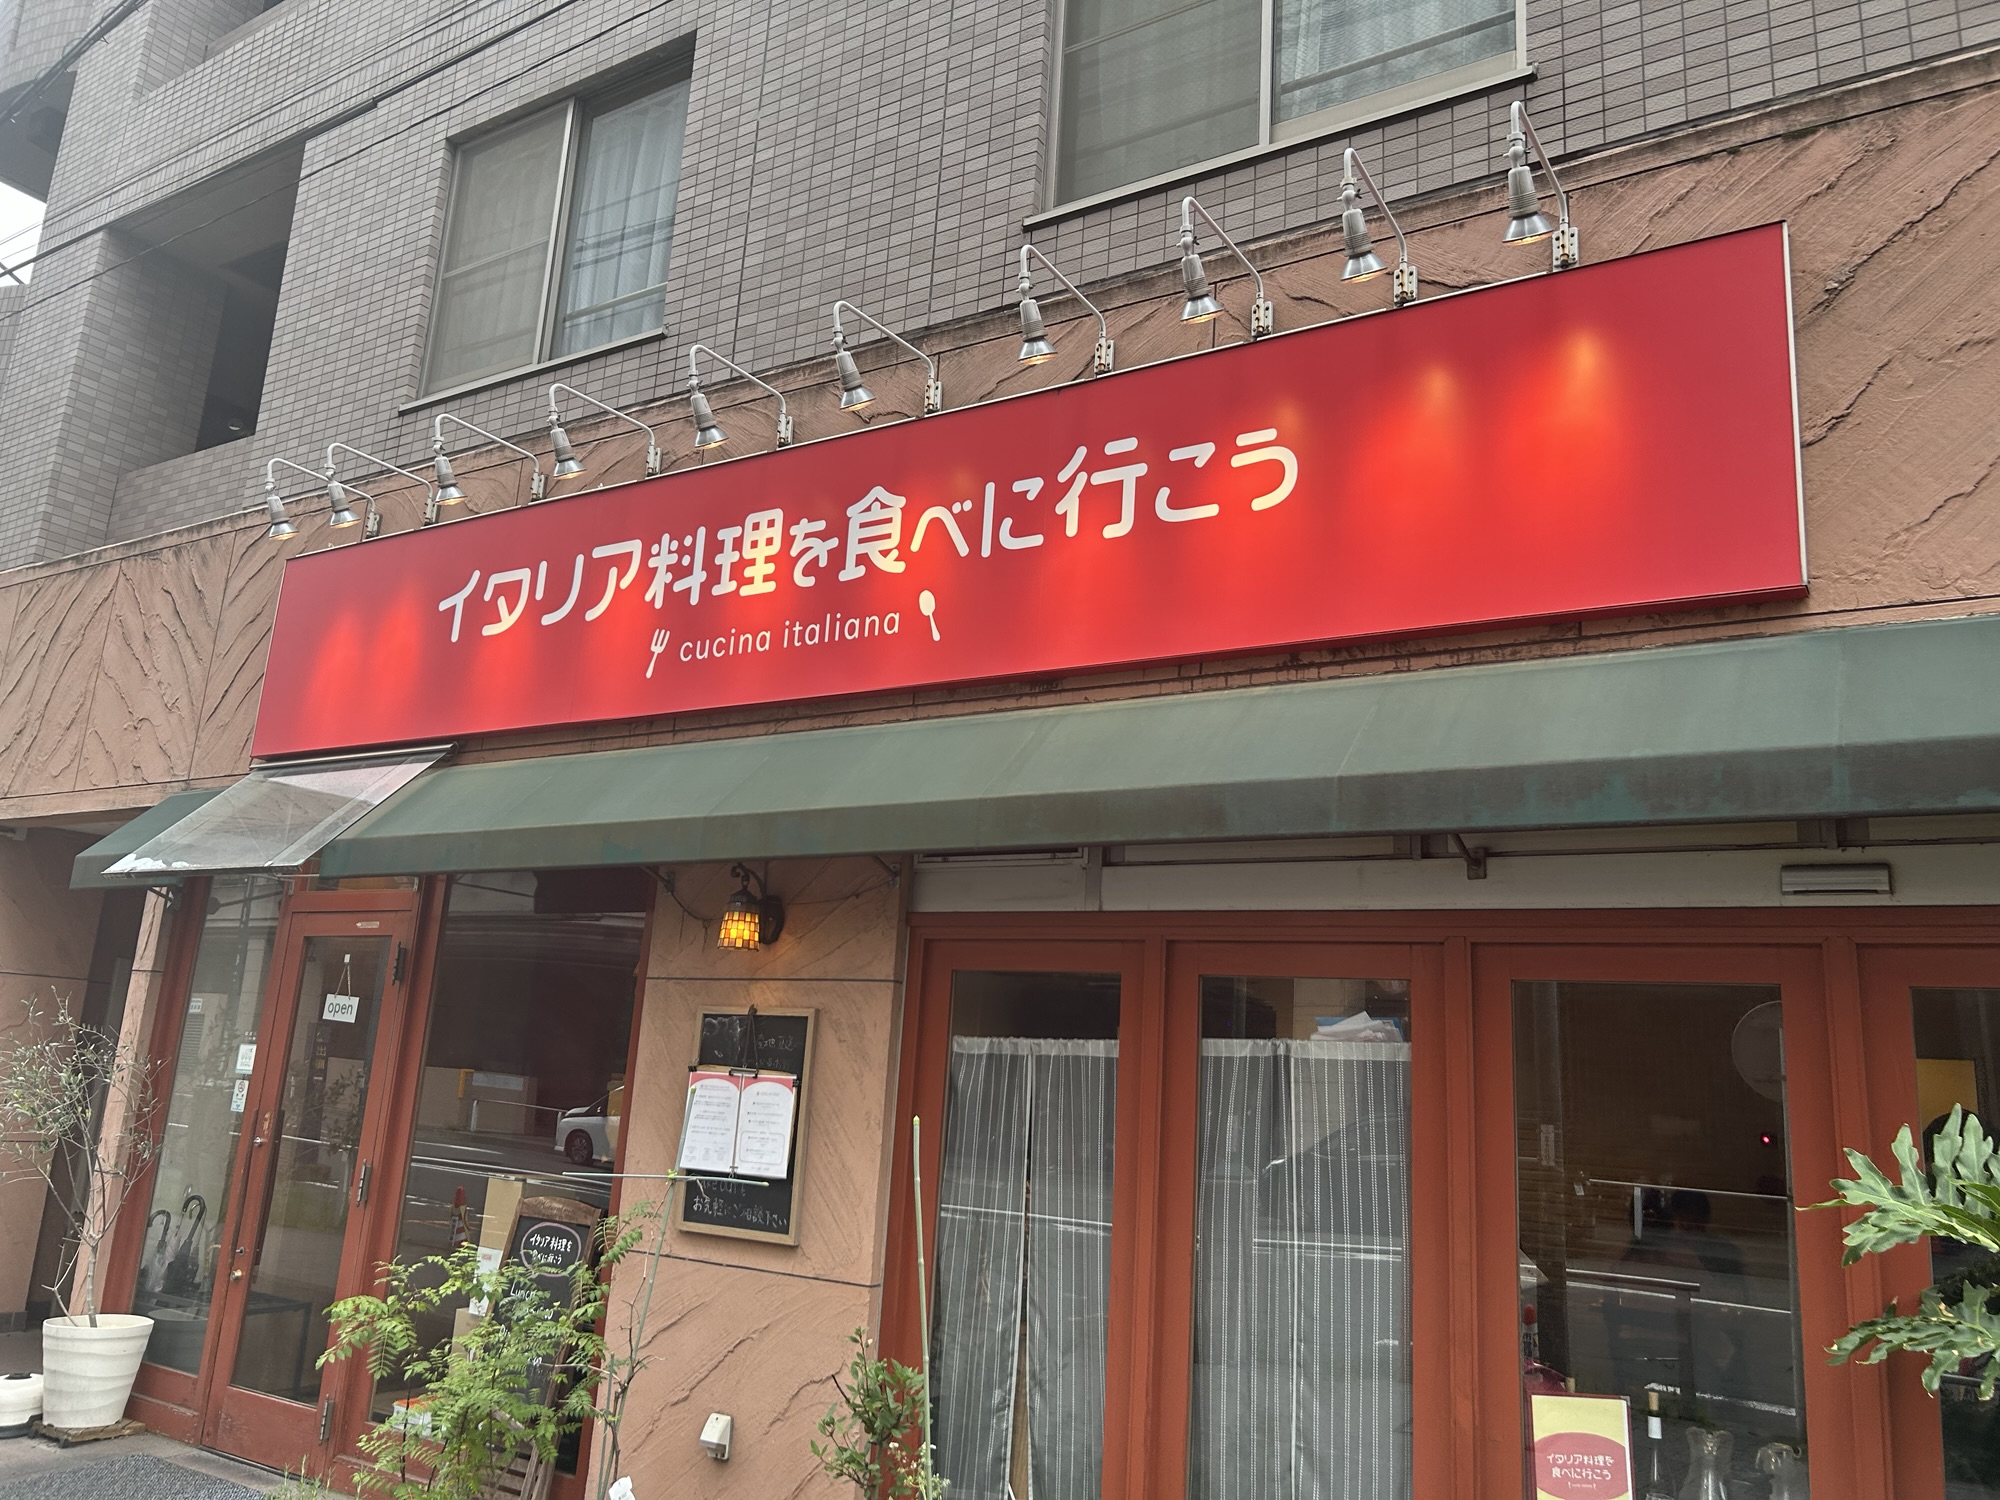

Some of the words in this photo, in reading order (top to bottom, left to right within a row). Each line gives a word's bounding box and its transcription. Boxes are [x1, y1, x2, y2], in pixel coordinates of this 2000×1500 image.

[438, 427, 1299, 643] イタリア料理を食べに行こう
[679, 627, 771, 662] cucina
[783, 611, 901, 649] italiana
[327, 1002, 353, 1017] open
[1546, 1452, 1615, 1467] イタリア料理を
[1551, 1466, 1612, 1481] 食べに行こう
